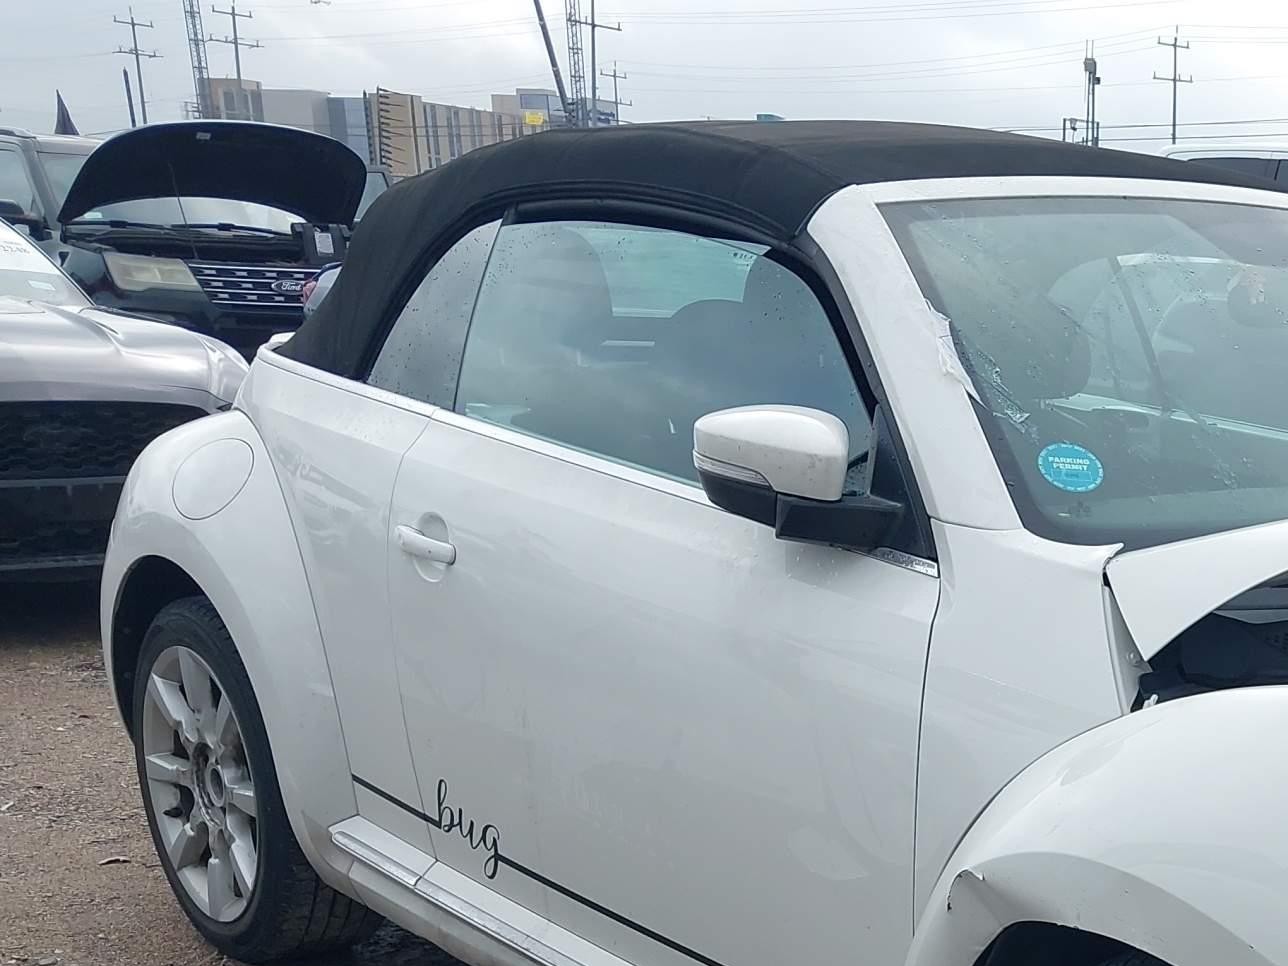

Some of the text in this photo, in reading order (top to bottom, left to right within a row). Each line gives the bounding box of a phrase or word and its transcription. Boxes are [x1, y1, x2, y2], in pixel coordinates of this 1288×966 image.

[1047, 456, 1090, 465] PARKING
[1053, 463, 1088, 471] PERMIT
[437, 779, 500, 879] bug
